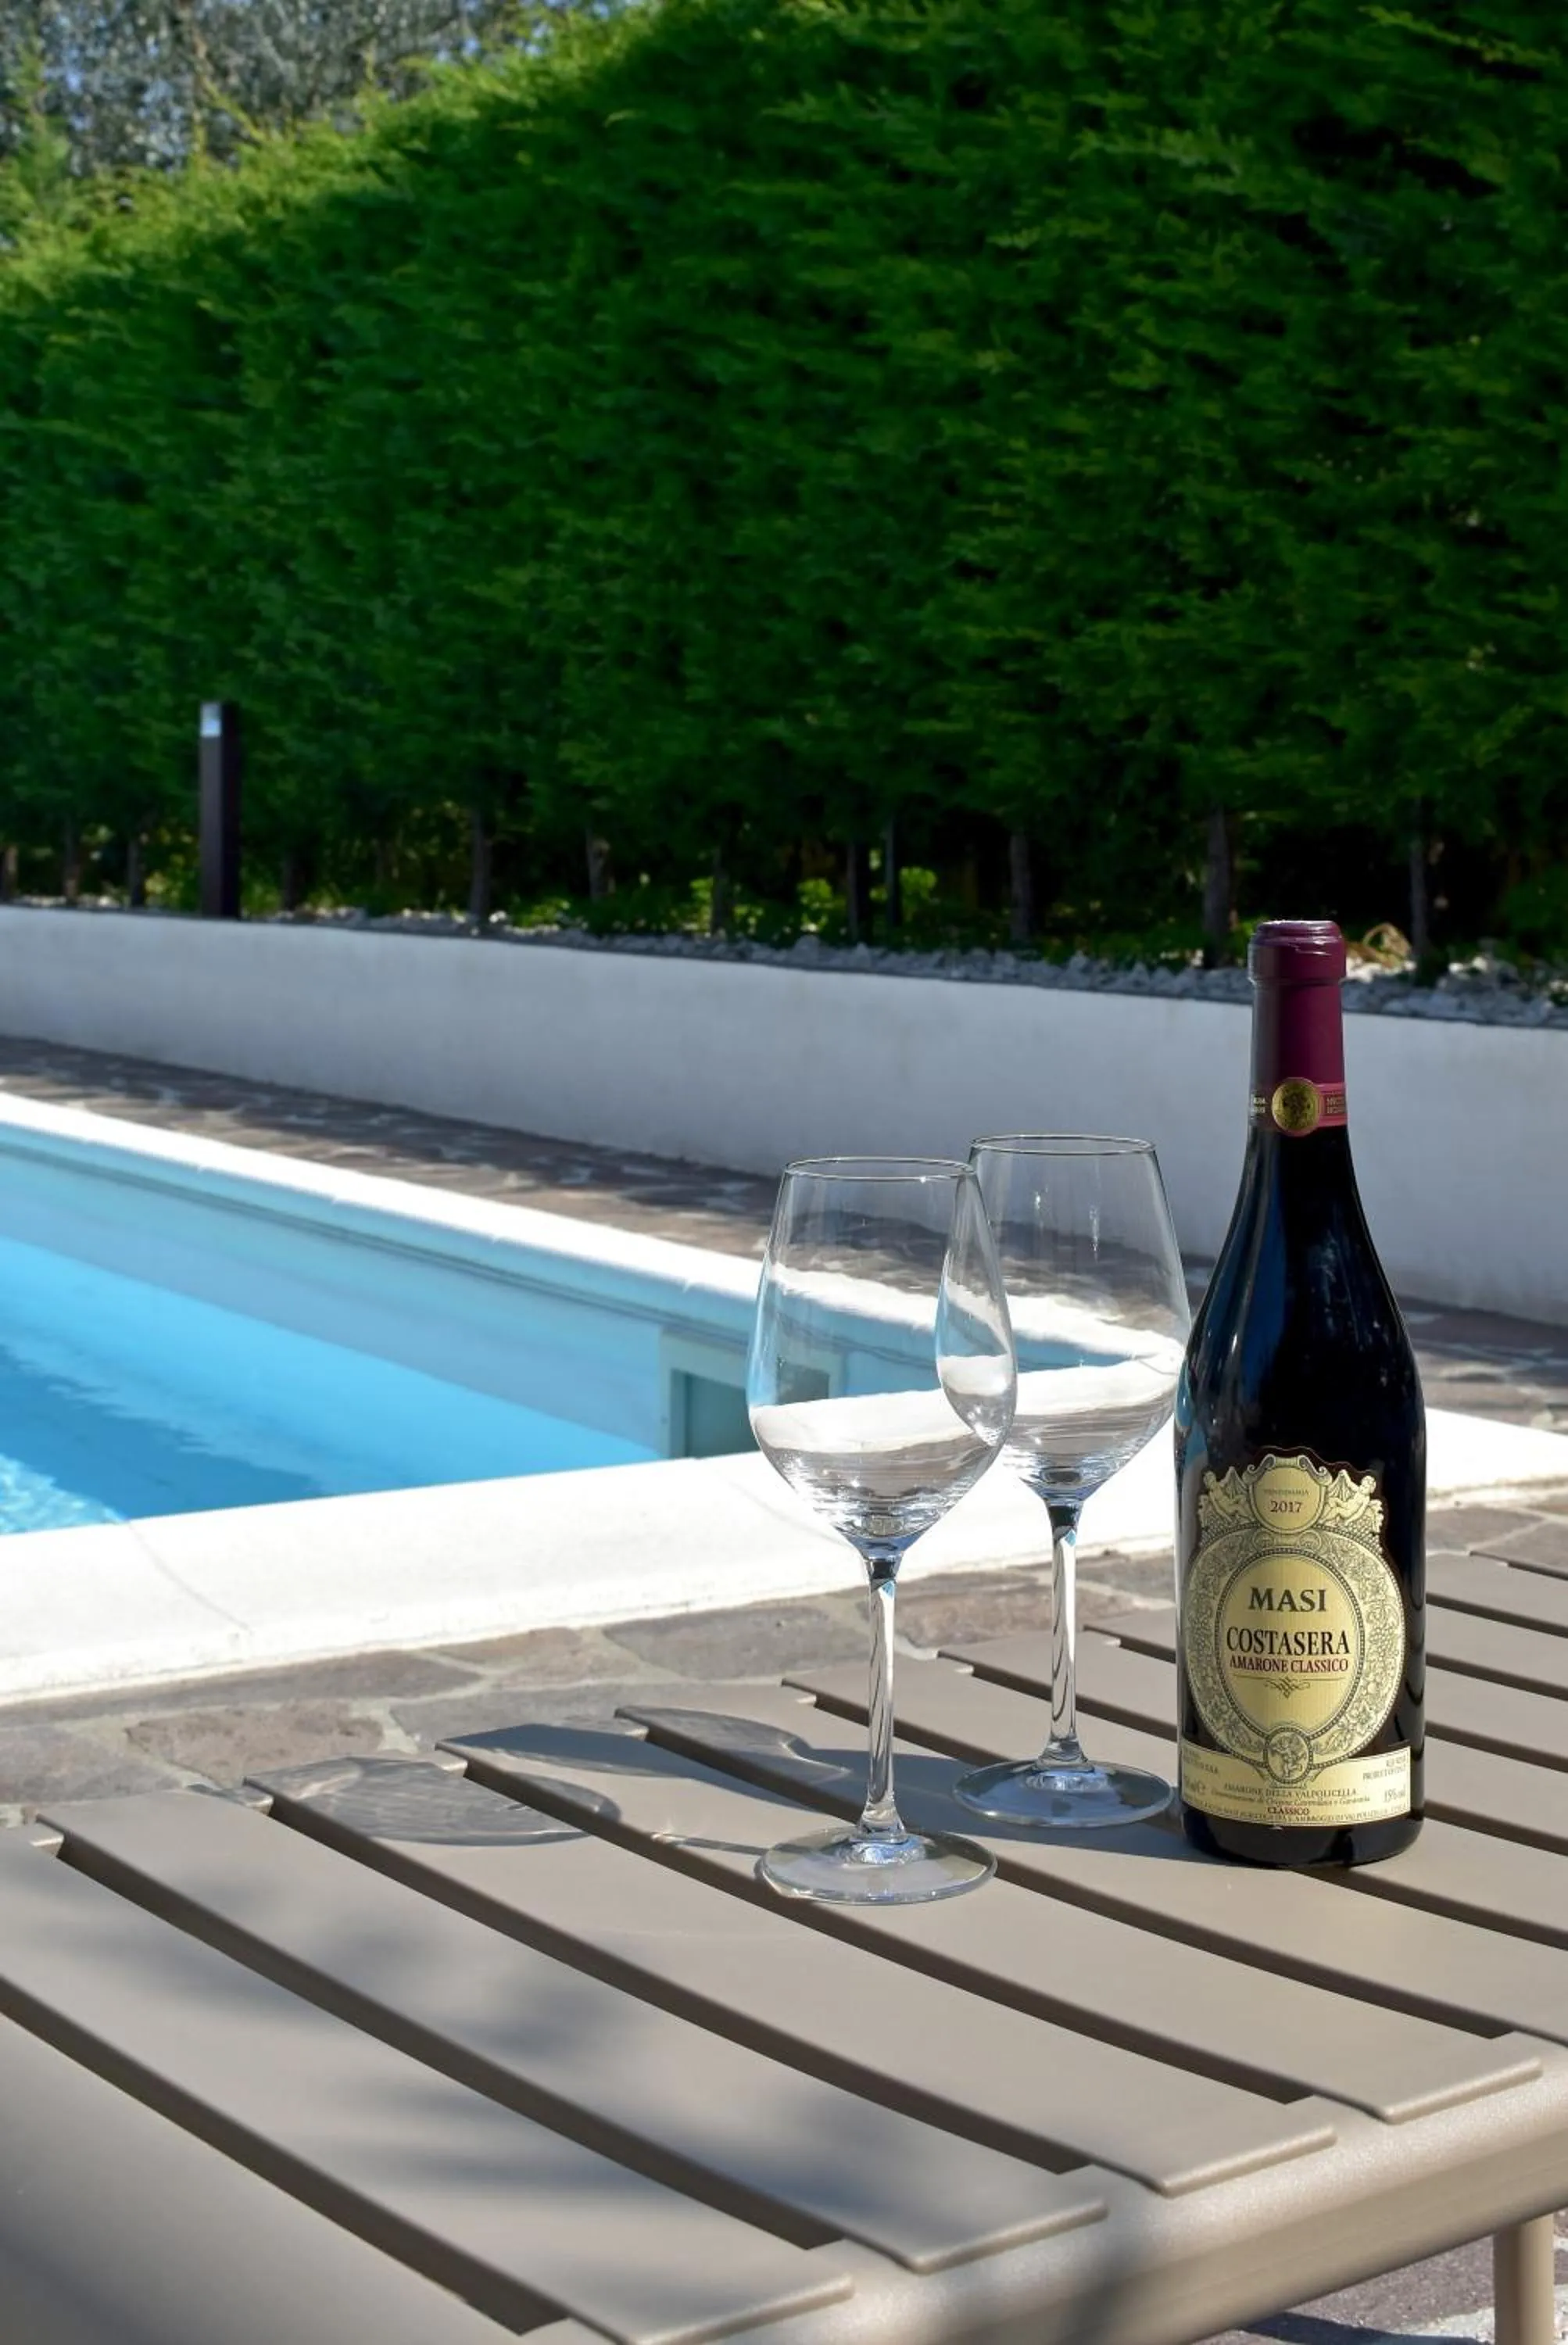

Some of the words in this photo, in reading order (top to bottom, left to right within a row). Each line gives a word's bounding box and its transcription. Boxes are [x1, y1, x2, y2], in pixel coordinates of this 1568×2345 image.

[1269, 1500, 1303, 1513] 2017
[1248, 1587, 1326, 1613] MASI
[1226, 1626, 1351, 1656] COSTASERA
[1230, 1655, 1288, 1674] AMARONE
[1291, 1658, 1348, 1674] CLASSICO
